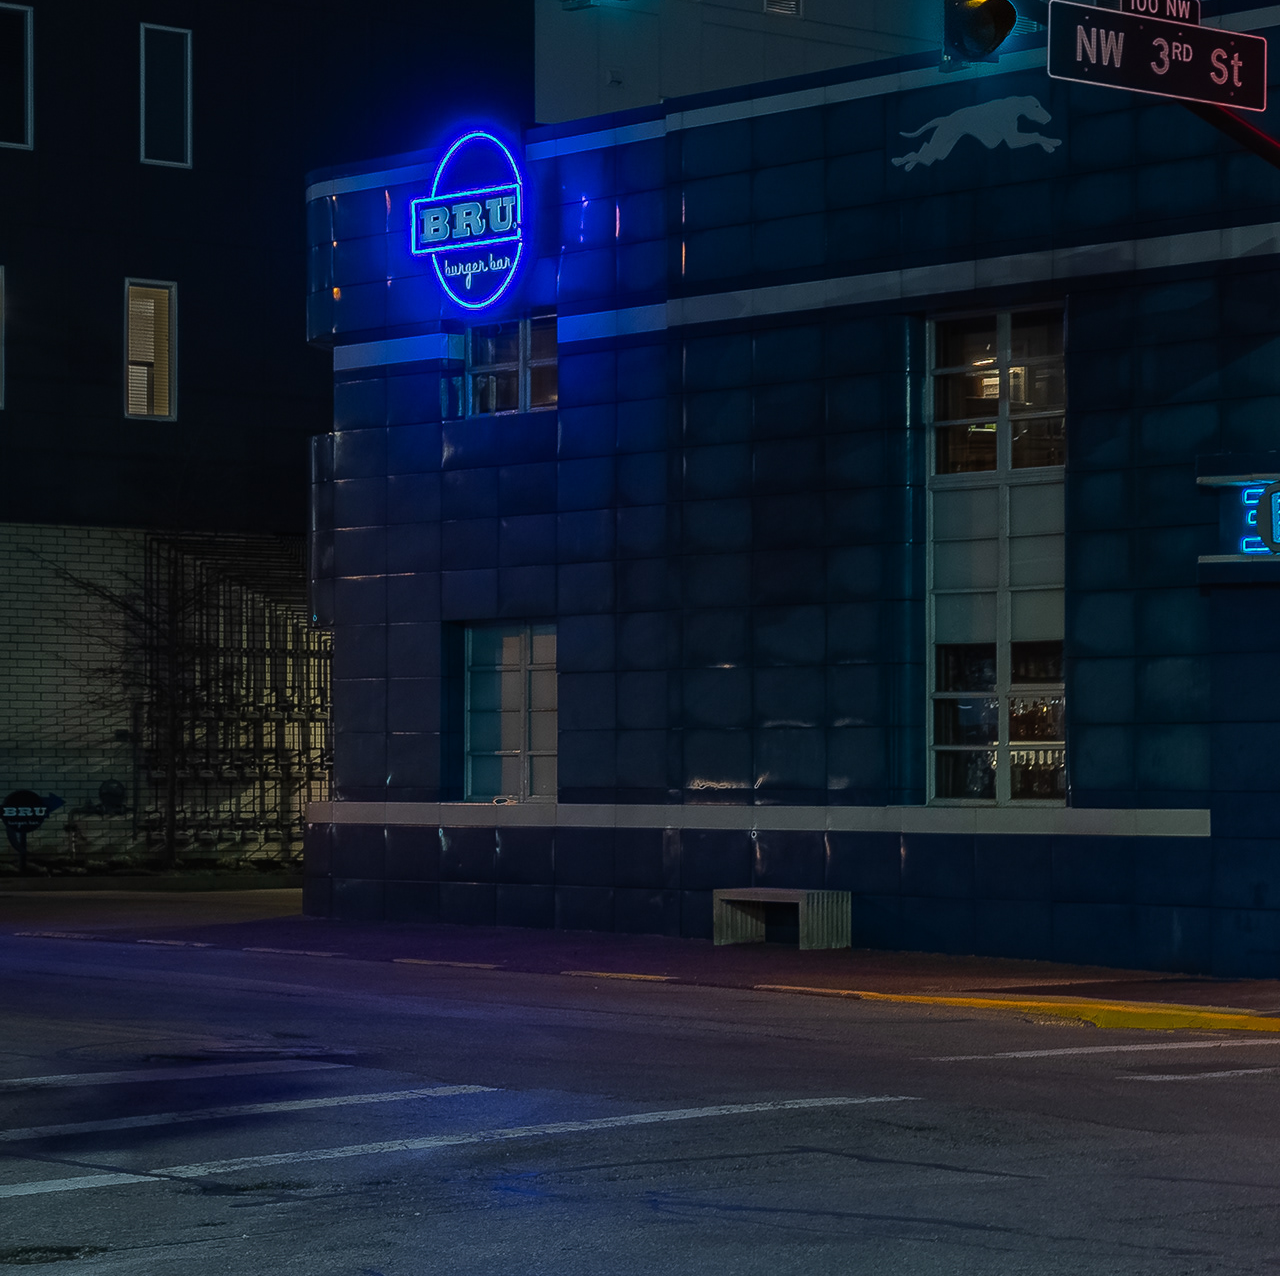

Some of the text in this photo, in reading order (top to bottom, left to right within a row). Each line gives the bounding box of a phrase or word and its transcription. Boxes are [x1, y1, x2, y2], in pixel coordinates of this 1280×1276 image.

[1075, 23, 1244, 88] NW 3RD St
[419, 194, 516, 244] BRU
[444, 252, 515, 290] burger bar
[2, 806, 48, 817] BRU
